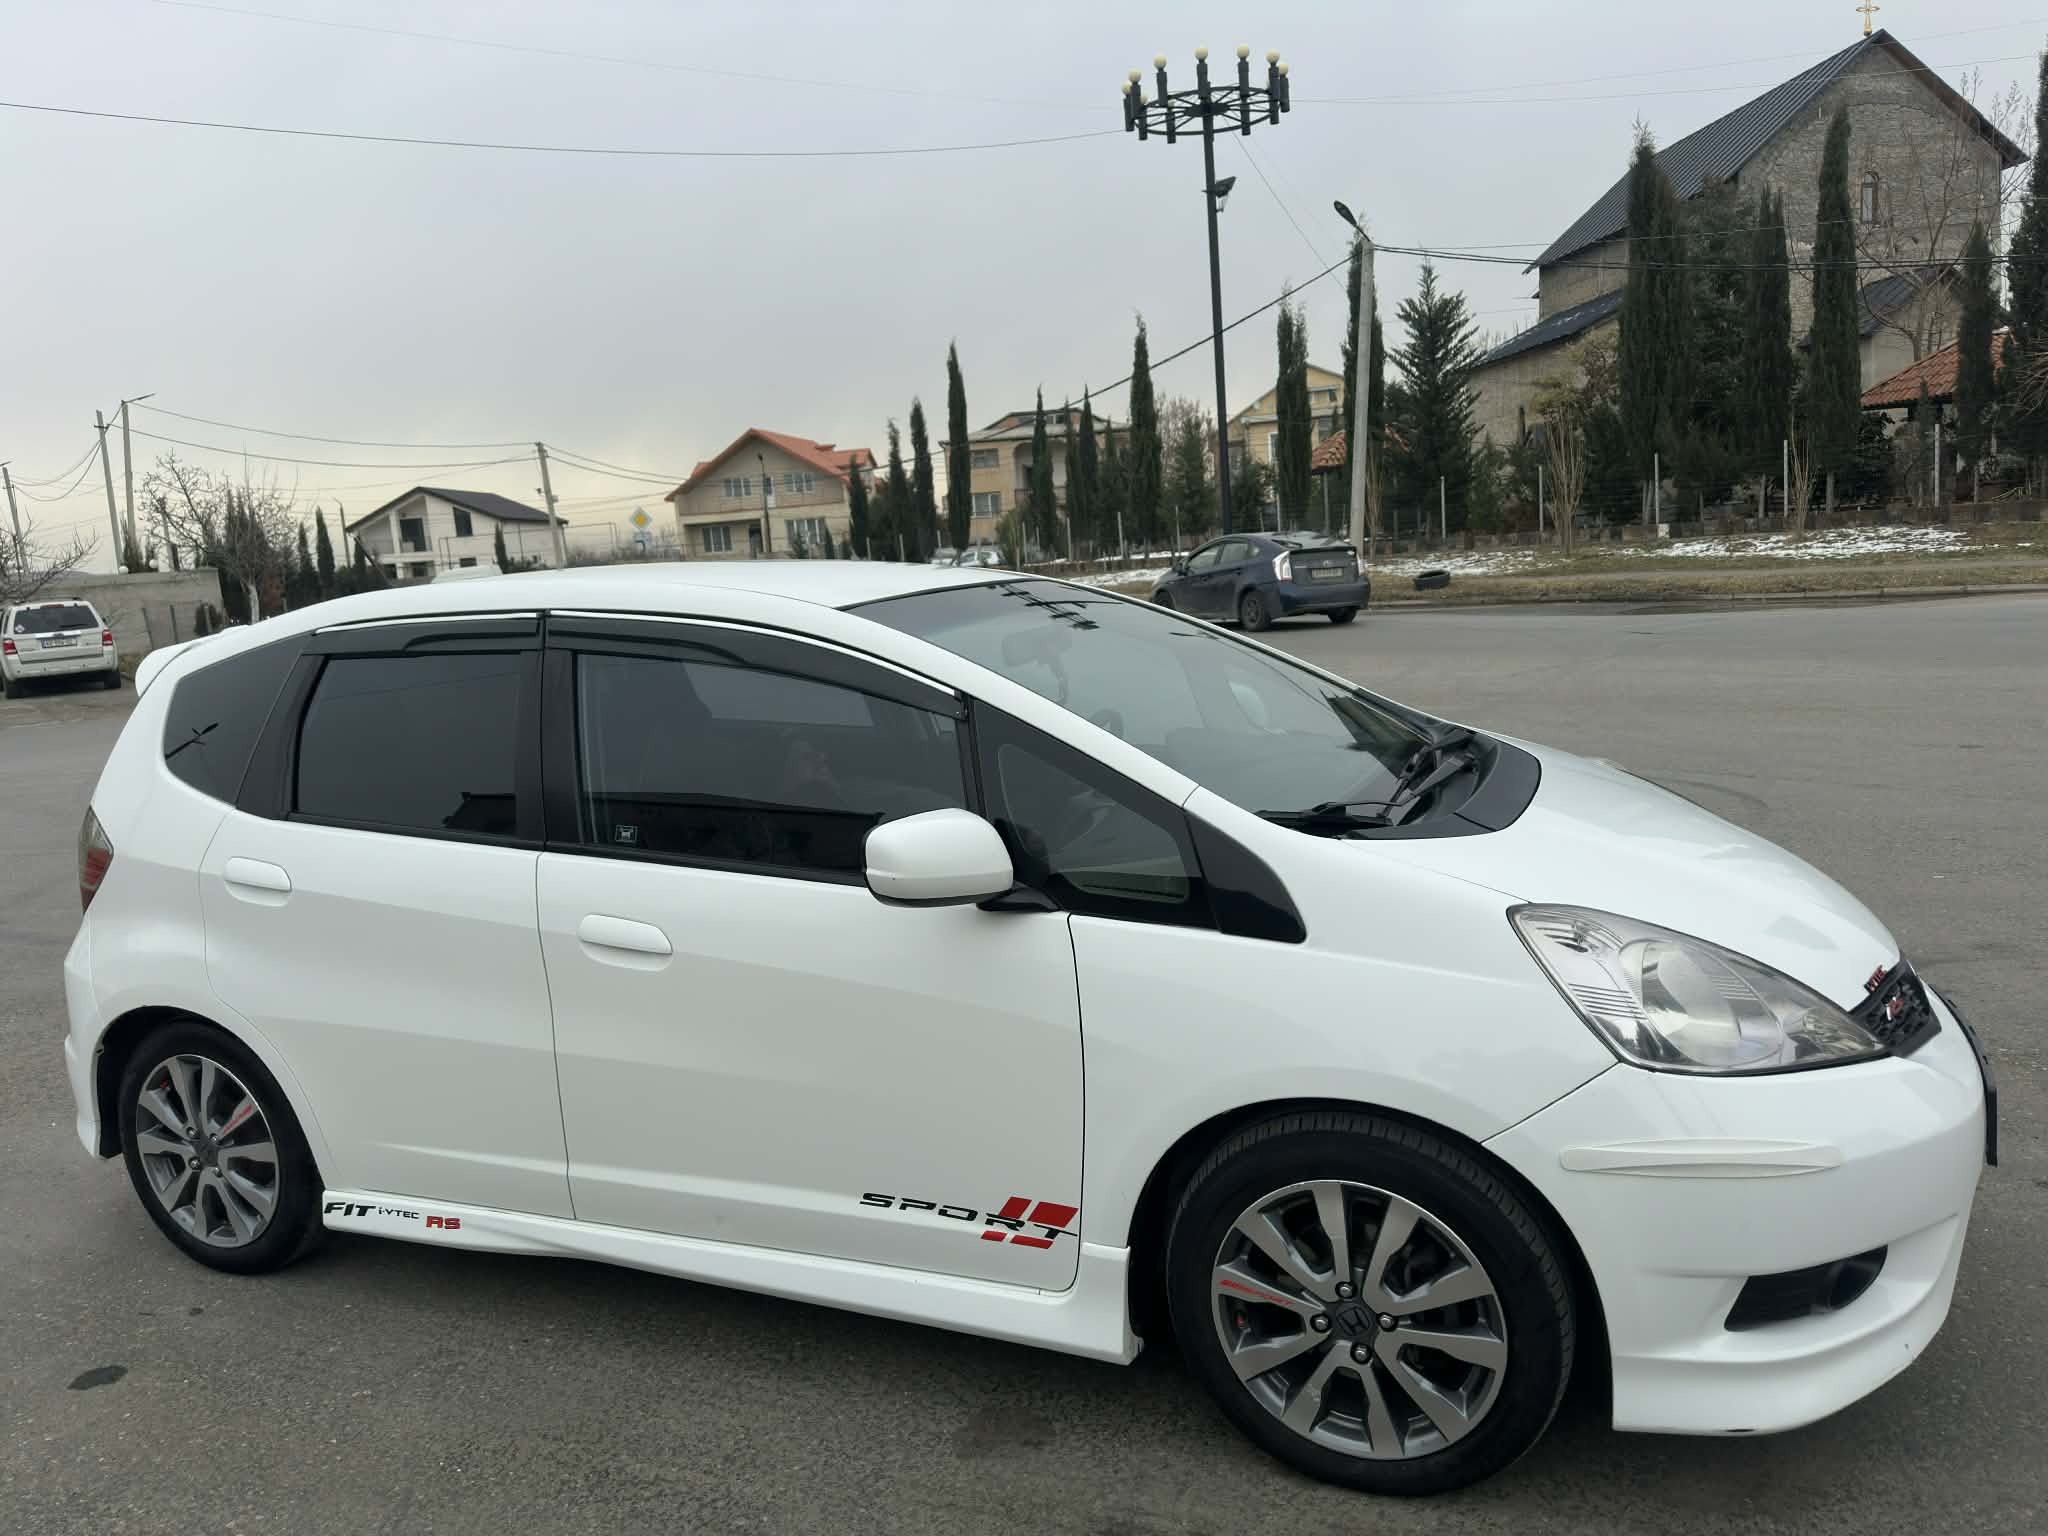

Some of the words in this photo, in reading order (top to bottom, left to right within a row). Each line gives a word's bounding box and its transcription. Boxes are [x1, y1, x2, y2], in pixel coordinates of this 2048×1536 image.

[323, 1201, 376, 1217] FIT
[426, 1215, 461, 1230] RS
[859, 1192, 1078, 1240] SPORT
